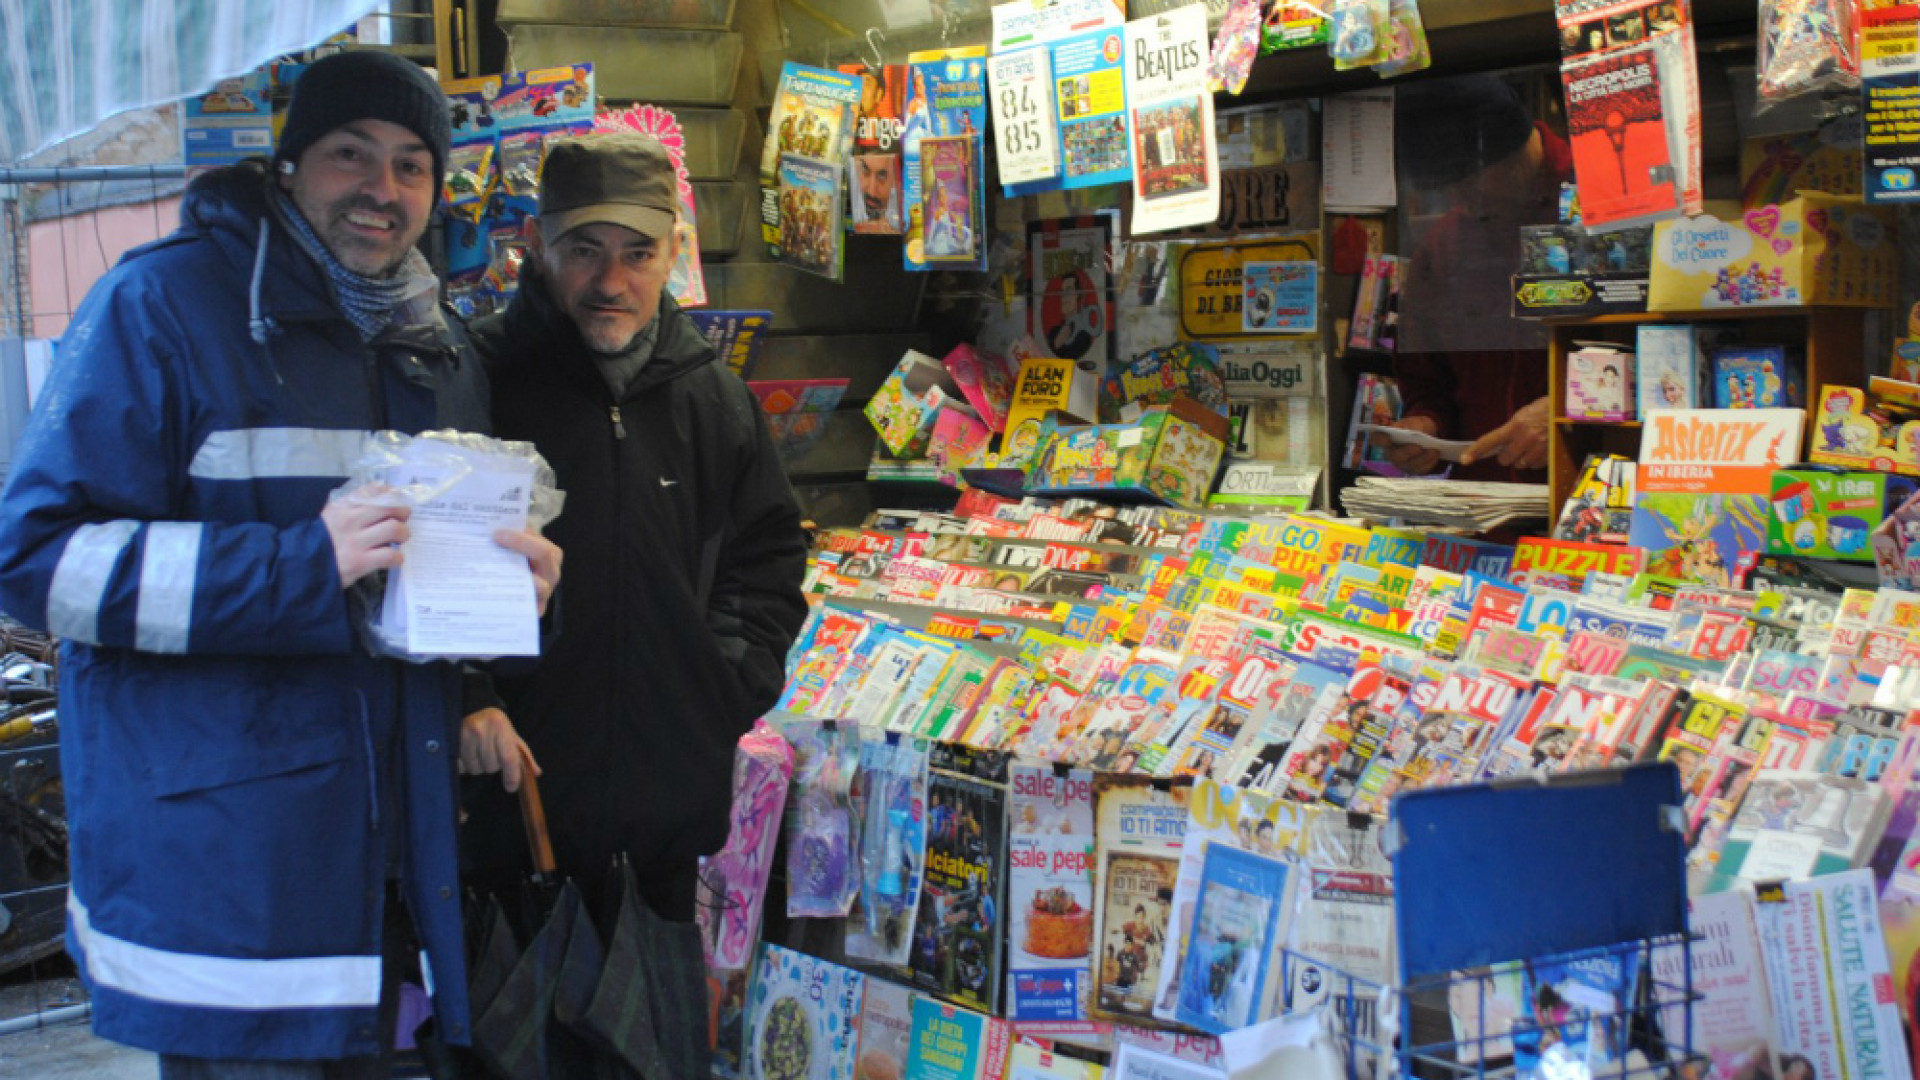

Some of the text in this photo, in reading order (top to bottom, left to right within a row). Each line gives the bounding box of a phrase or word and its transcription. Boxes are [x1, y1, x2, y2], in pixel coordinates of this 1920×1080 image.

[1135, 38, 1200, 82] BEATLES
[1568, 64, 1651, 93] NECROPOLIS
[1001, 84, 1038, 119] 84
[1004, 119, 1041, 155] 85
[1205, 268, 1242, 288] GIOR
[1021, 382, 1063, 397] FORD
[1024, 367, 1065, 382] ALAN
[1224, 360, 1303, 389] liaOggi
[1648, 465, 1715, 480] IN IBERIA
[1512, 545, 1636, 579] PUZZLE
[1753, 660, 1819, 693] SUS
[1013, 770, 1092, 807] sale pe
[1120, 817, 1135, 834] IO
[1138, 818, 1150, 834] TI
[926, 847, 989, 882] lciatori
[1010, 845, 1048, 869] sale
[1833, 883, 1884, 1080] SALUTE NATURAL
[1797, 1009, 1810, 1050] vita
[1173, 1033, 1222, 1064] pep
[1819, 1050, 1836, 1080] col
